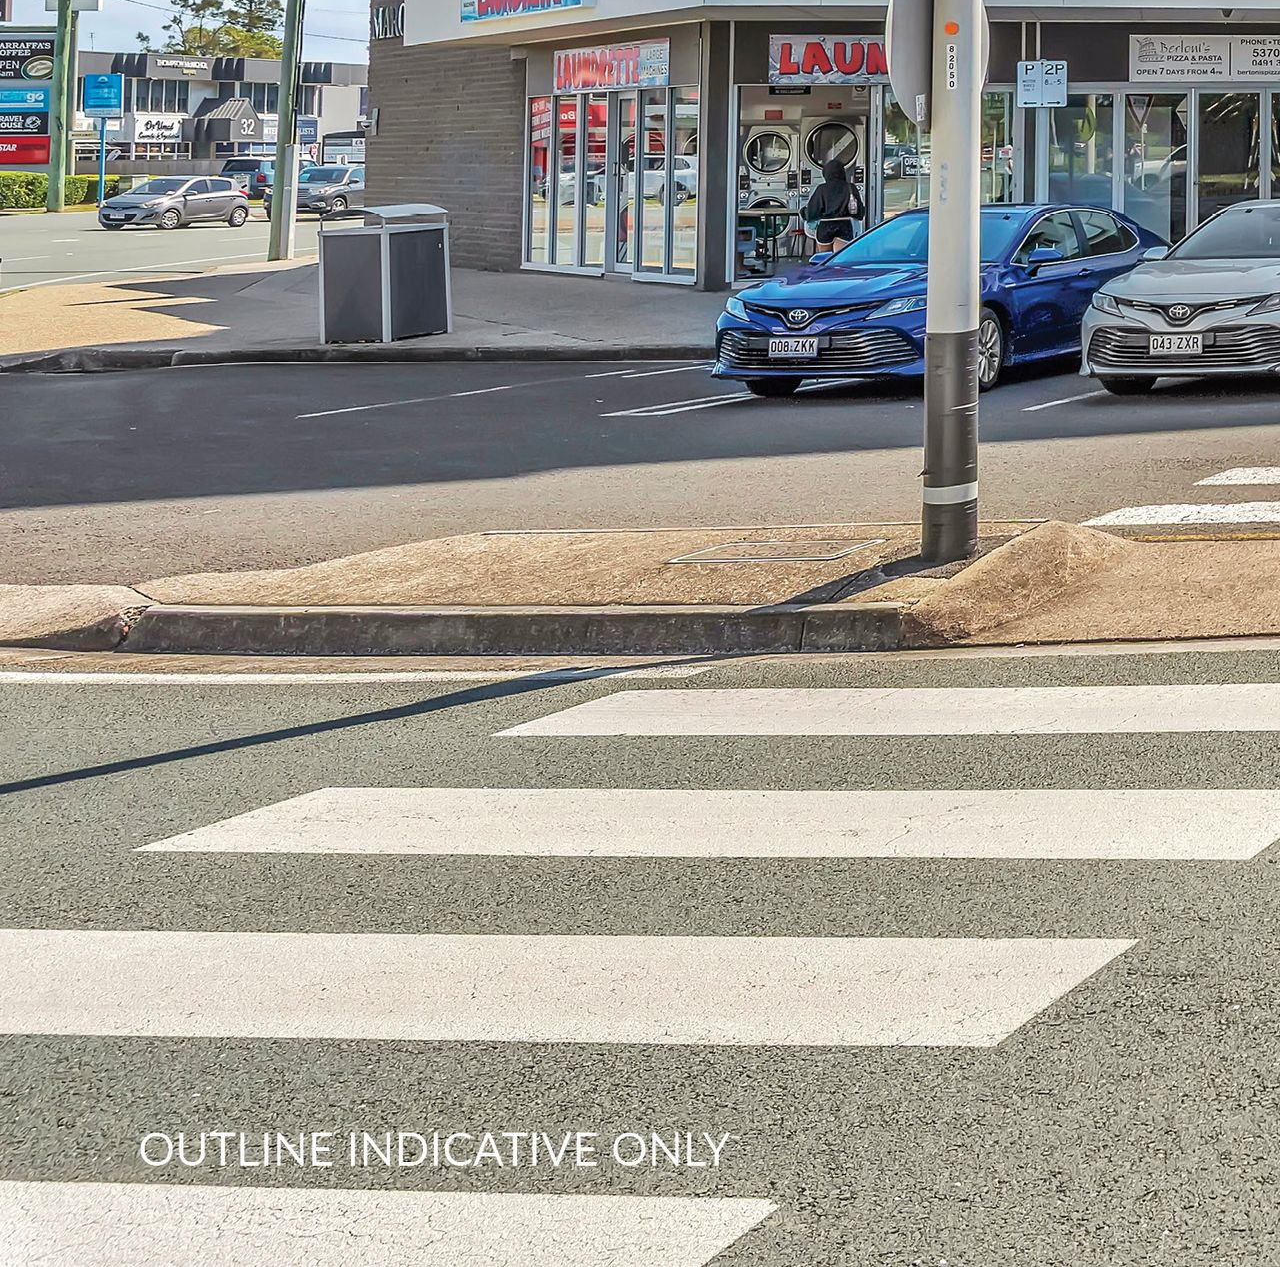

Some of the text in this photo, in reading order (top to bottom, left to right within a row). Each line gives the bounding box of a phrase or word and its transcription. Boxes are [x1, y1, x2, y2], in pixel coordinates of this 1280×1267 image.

[1160, 39, 1211, 53] Bertoni's
[1252, 48, 1280, 57] 5370
[779, 41, 888, 76] LAUN
[556, 45, 641, 91] LAUNDRETTE
[1025, 64, 1035, 75] P
[1044, 63, 1065, 75] 2P
[1159, 67, 1165, 75] 7
[240, 118, 255, 135] 32
